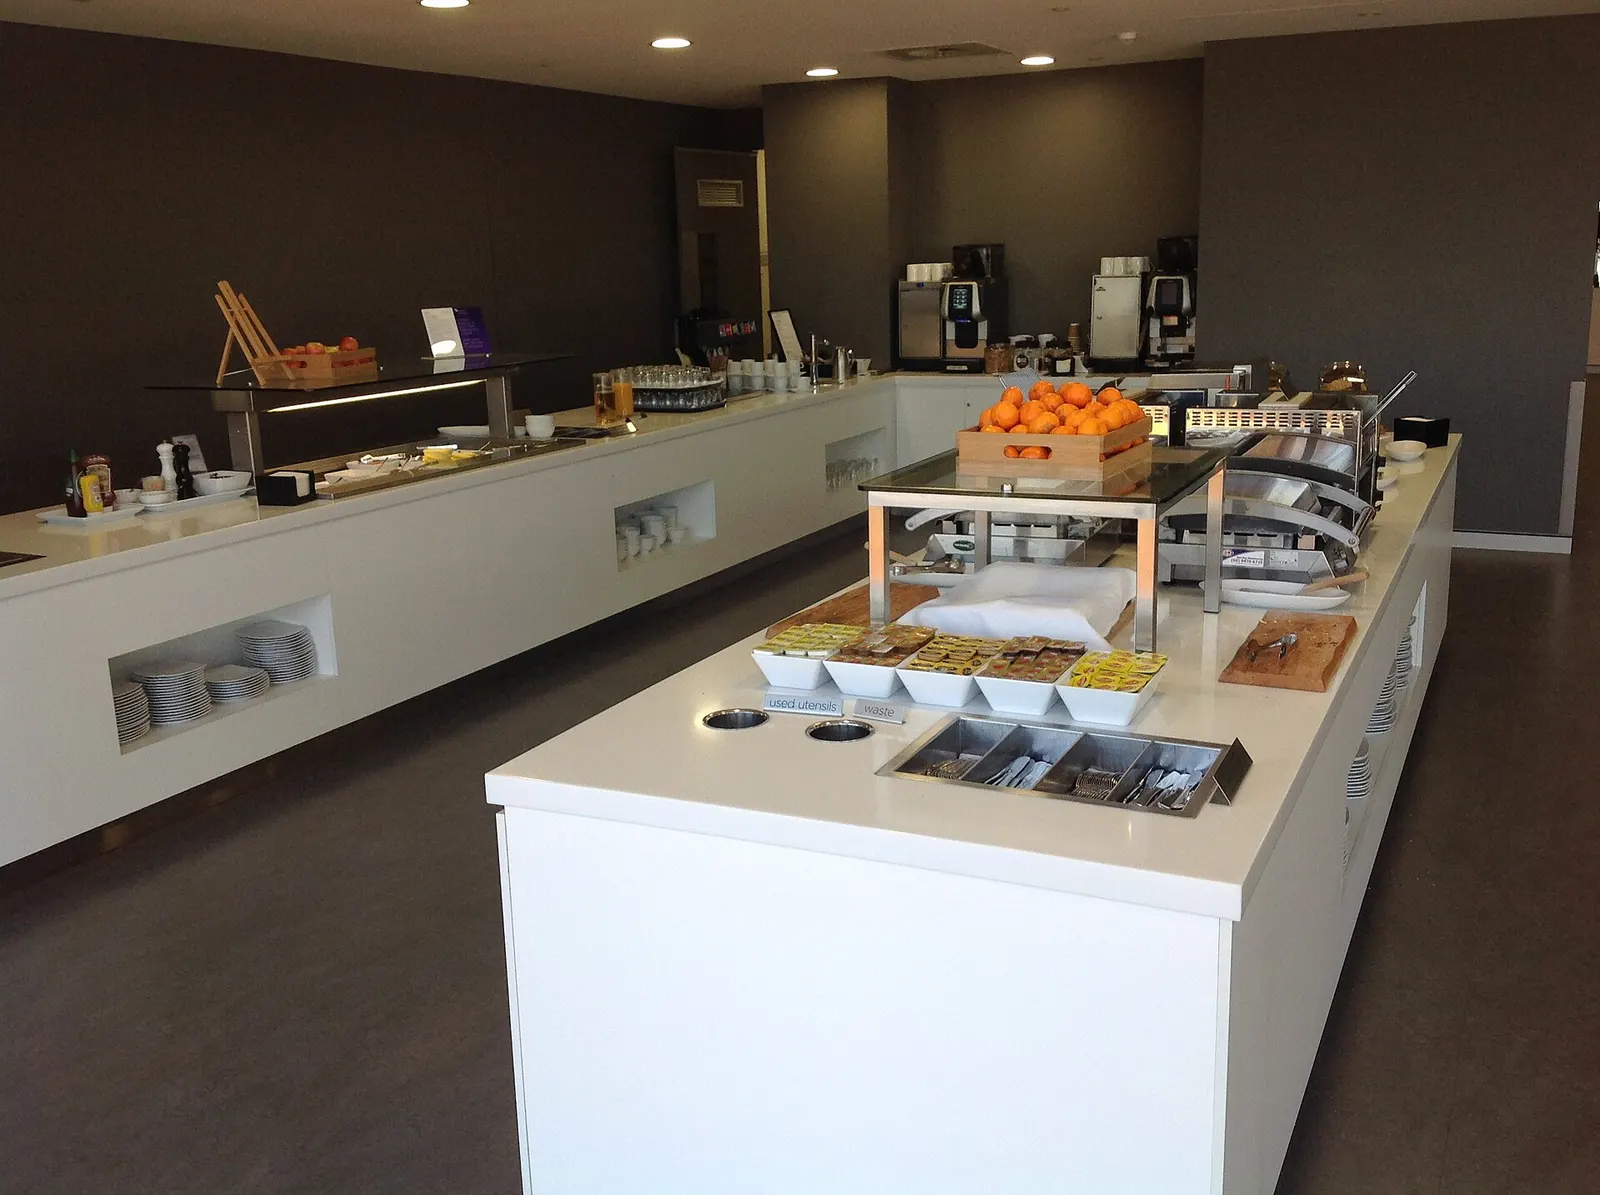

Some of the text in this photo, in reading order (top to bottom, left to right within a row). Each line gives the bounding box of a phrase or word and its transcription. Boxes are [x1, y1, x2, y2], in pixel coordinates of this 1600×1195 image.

[769, 698, 837, 712] used utensils
[864, 705, 895, 718] waste
